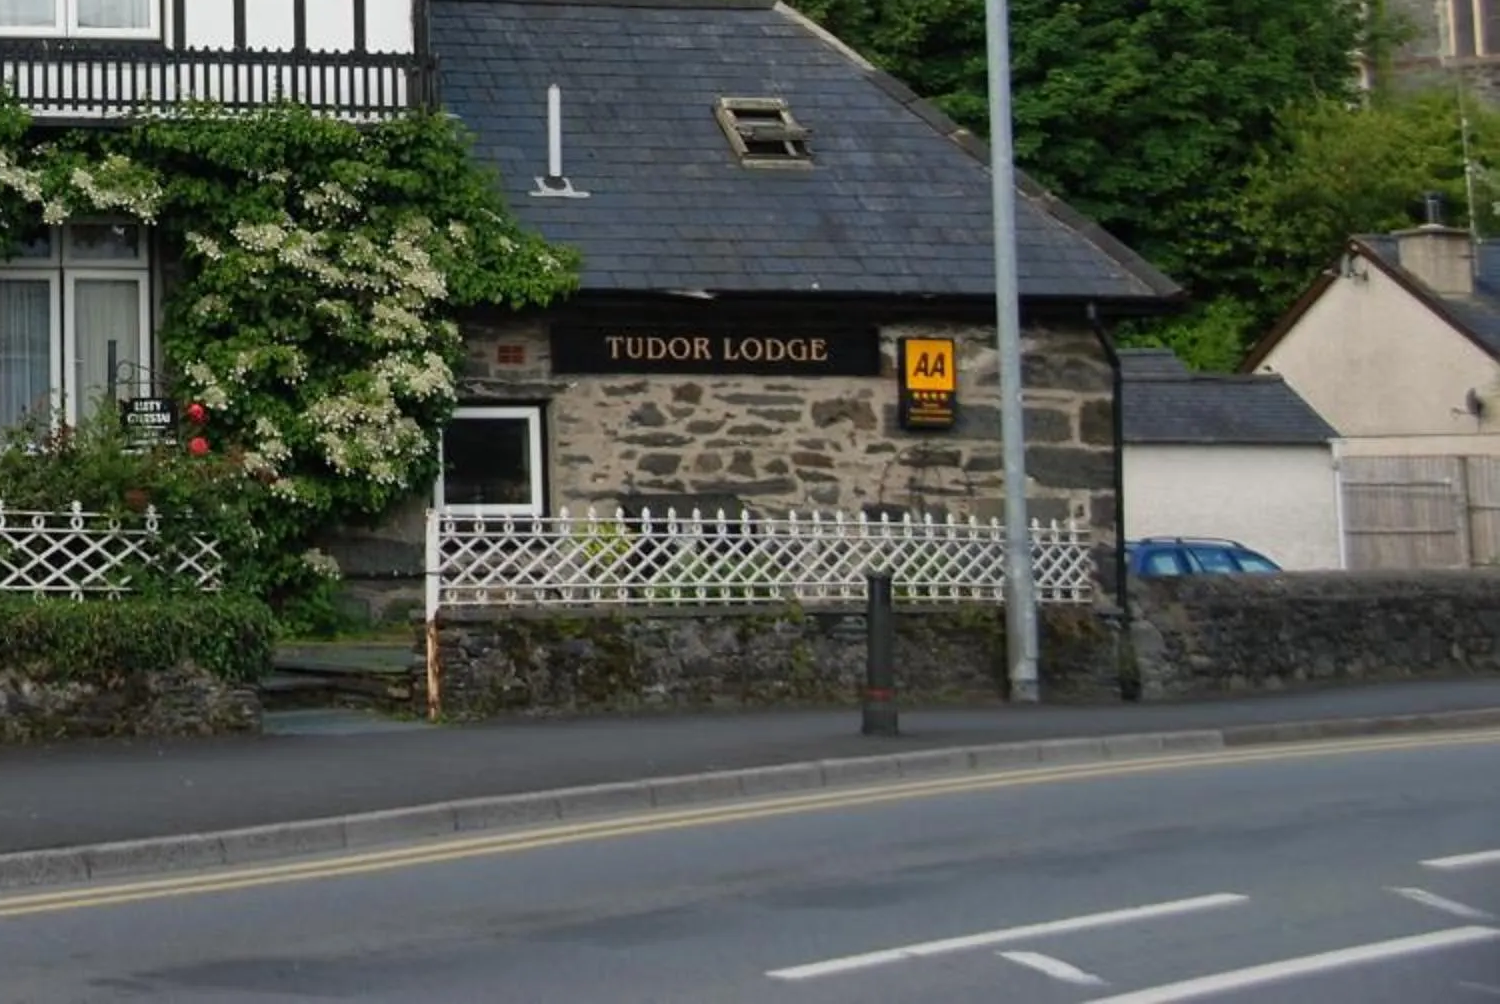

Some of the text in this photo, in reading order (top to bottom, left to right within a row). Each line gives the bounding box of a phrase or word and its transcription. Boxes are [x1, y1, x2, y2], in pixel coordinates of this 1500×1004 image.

[605, 336, 828, 361] TUDOR LODGE
[912, 351, 946, 377] AA
